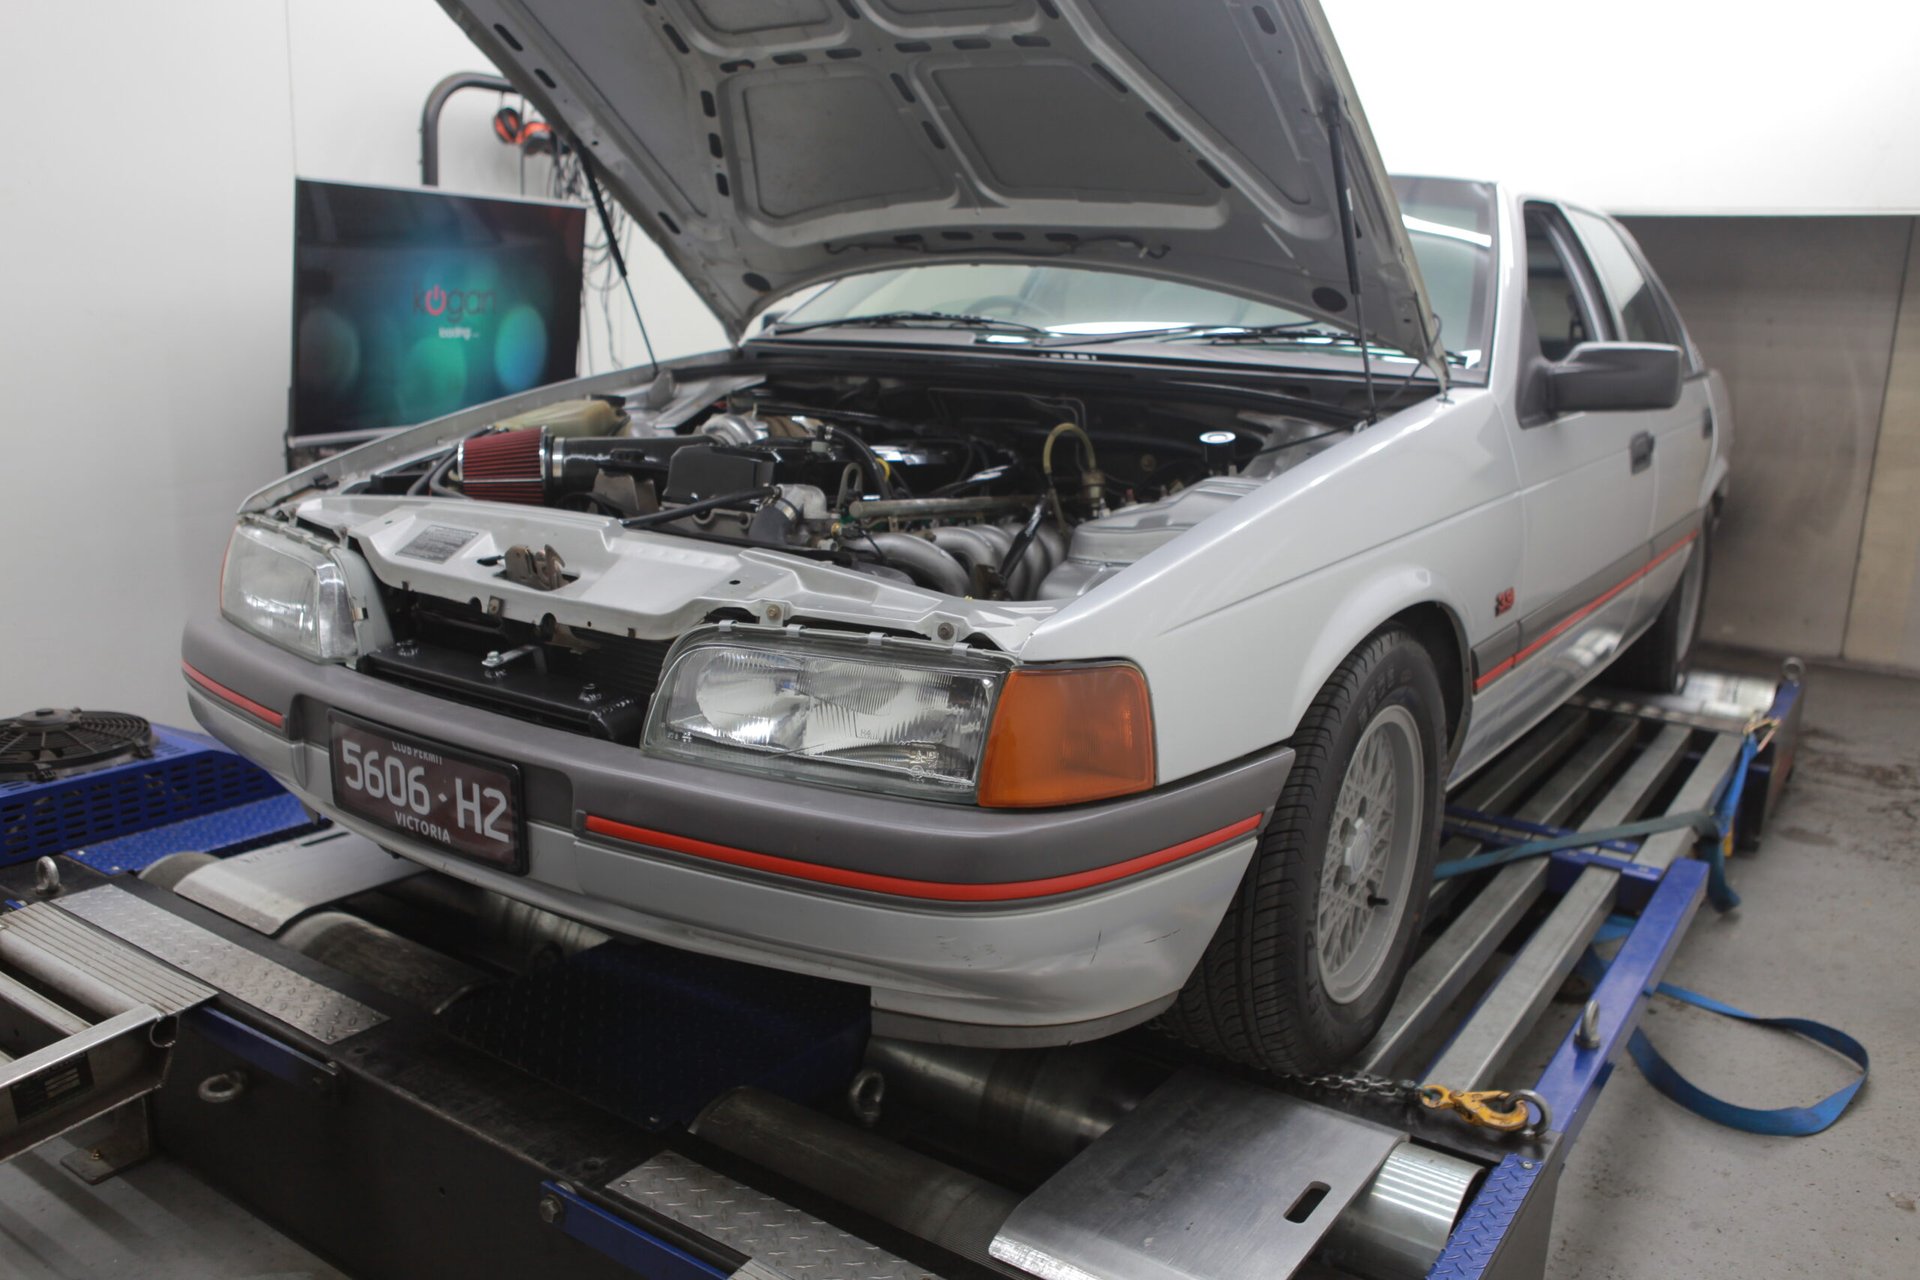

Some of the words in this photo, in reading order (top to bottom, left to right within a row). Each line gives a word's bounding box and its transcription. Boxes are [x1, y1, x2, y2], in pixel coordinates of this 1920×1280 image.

[342, 739, 431, 816] 5606
[455, 777, 510, 844] H2
[394, 810, 451, 844] VICTORIA
